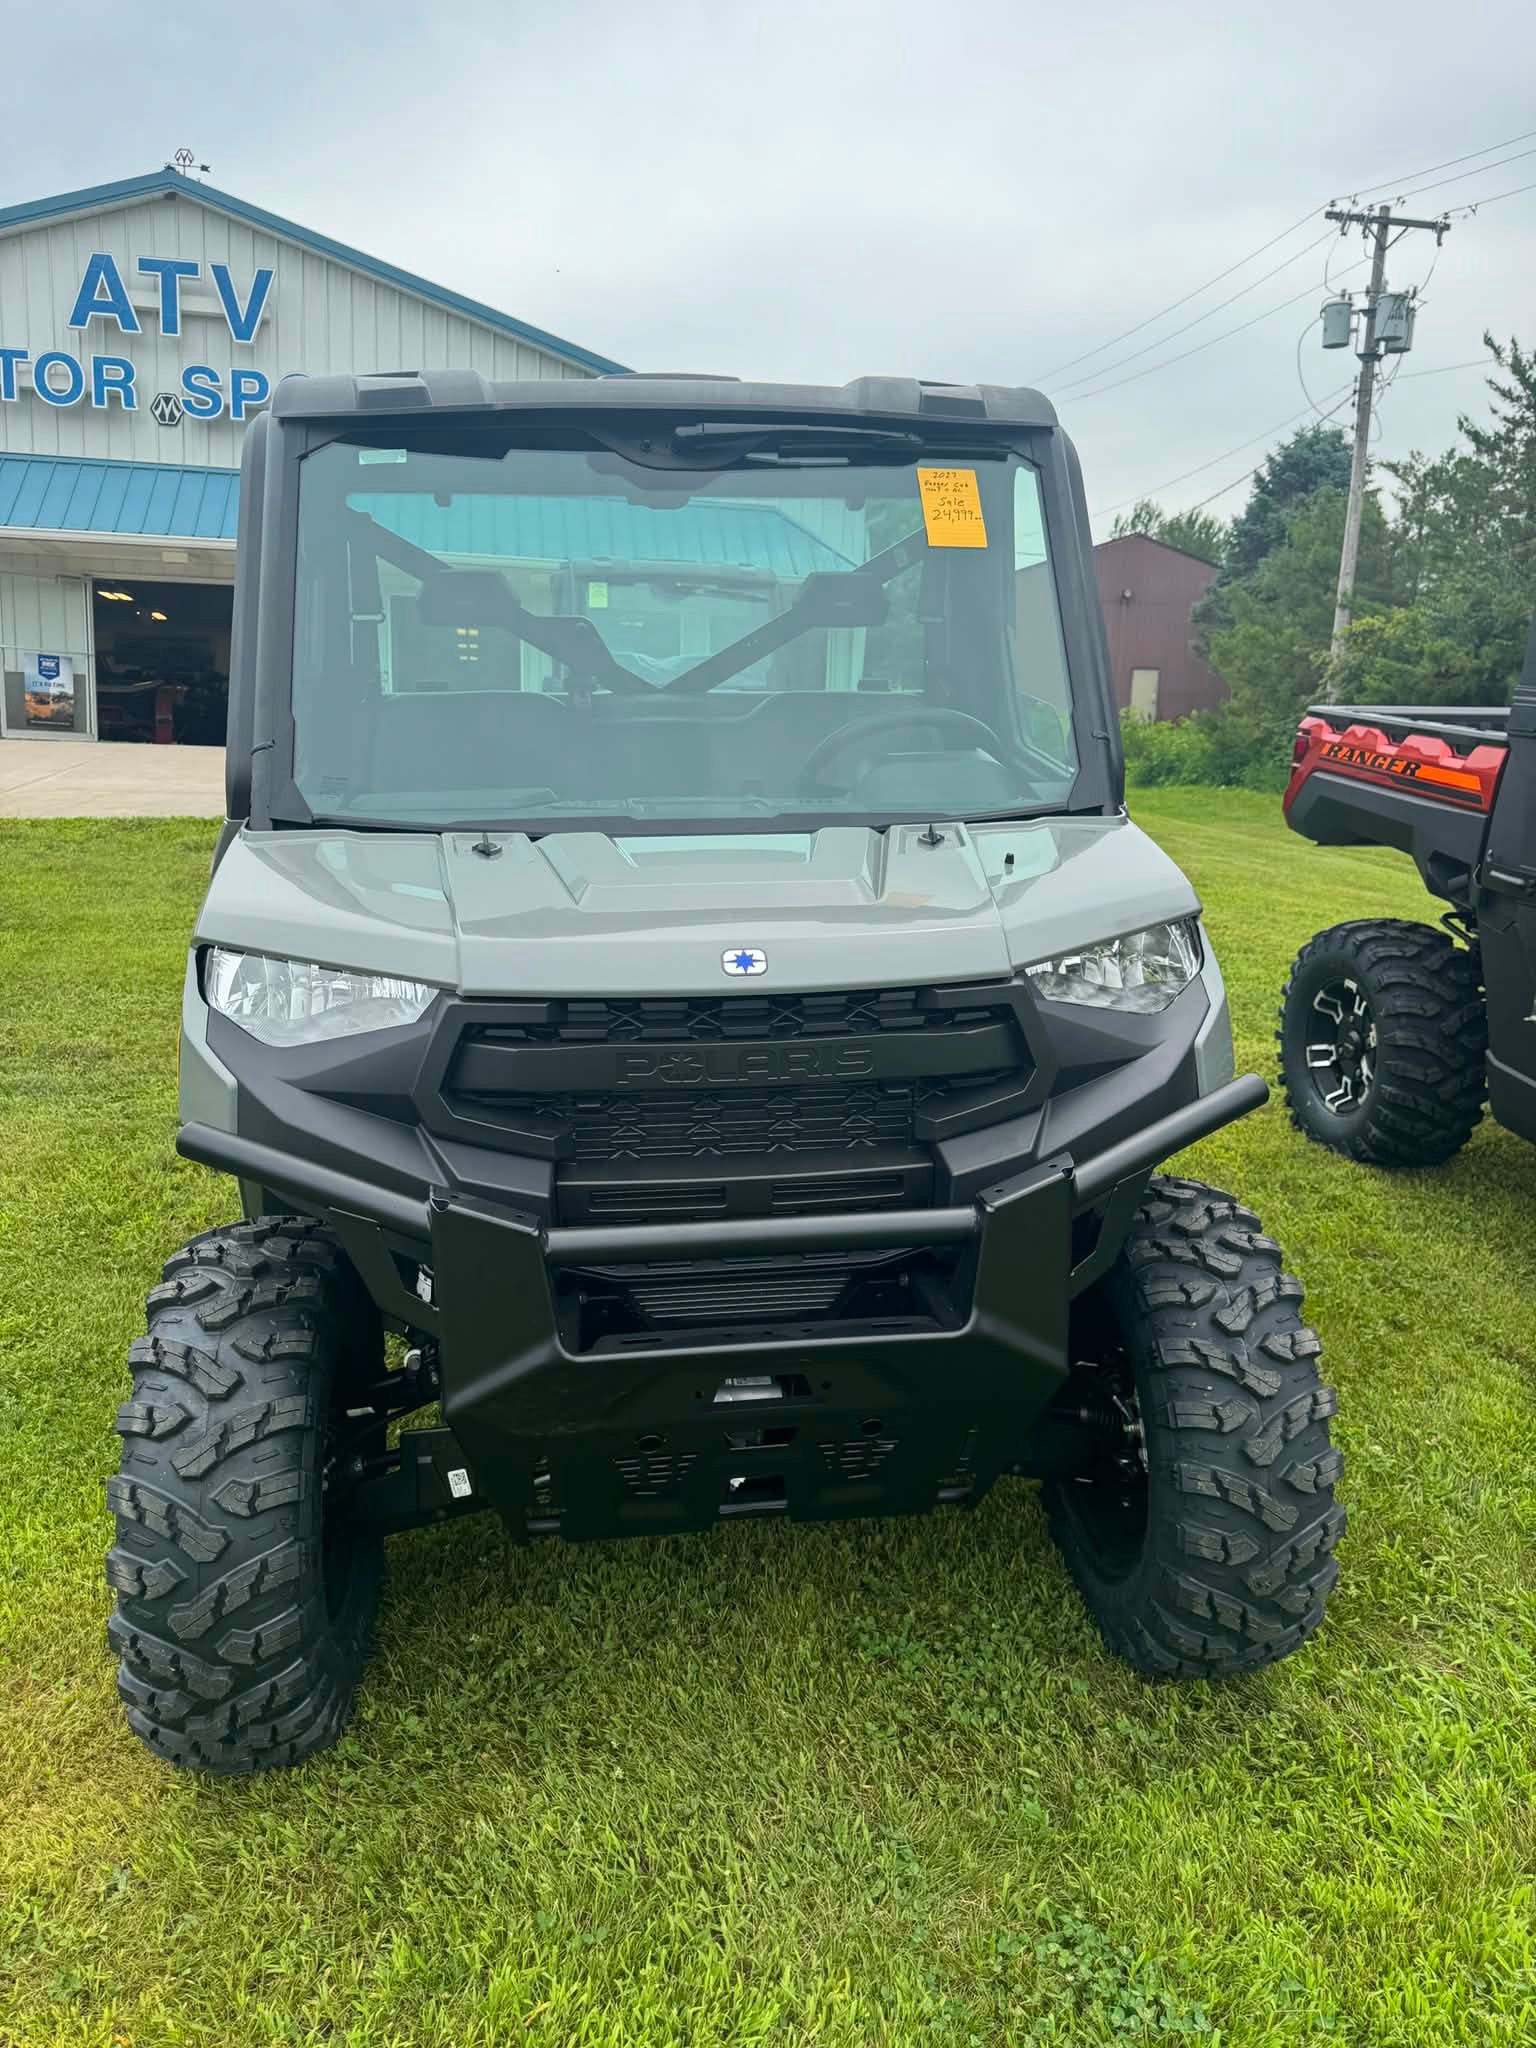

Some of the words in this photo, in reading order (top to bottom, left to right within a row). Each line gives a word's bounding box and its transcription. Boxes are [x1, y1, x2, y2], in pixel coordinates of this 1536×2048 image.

[68, 251, 275, 343] ATV
[0, 348, 138, 410] TOR
[937, 496, 965, 507] Sale
[1324, 744, 1422, 777] RANGER
[615, 1045, 874, 1086] POLARIS
